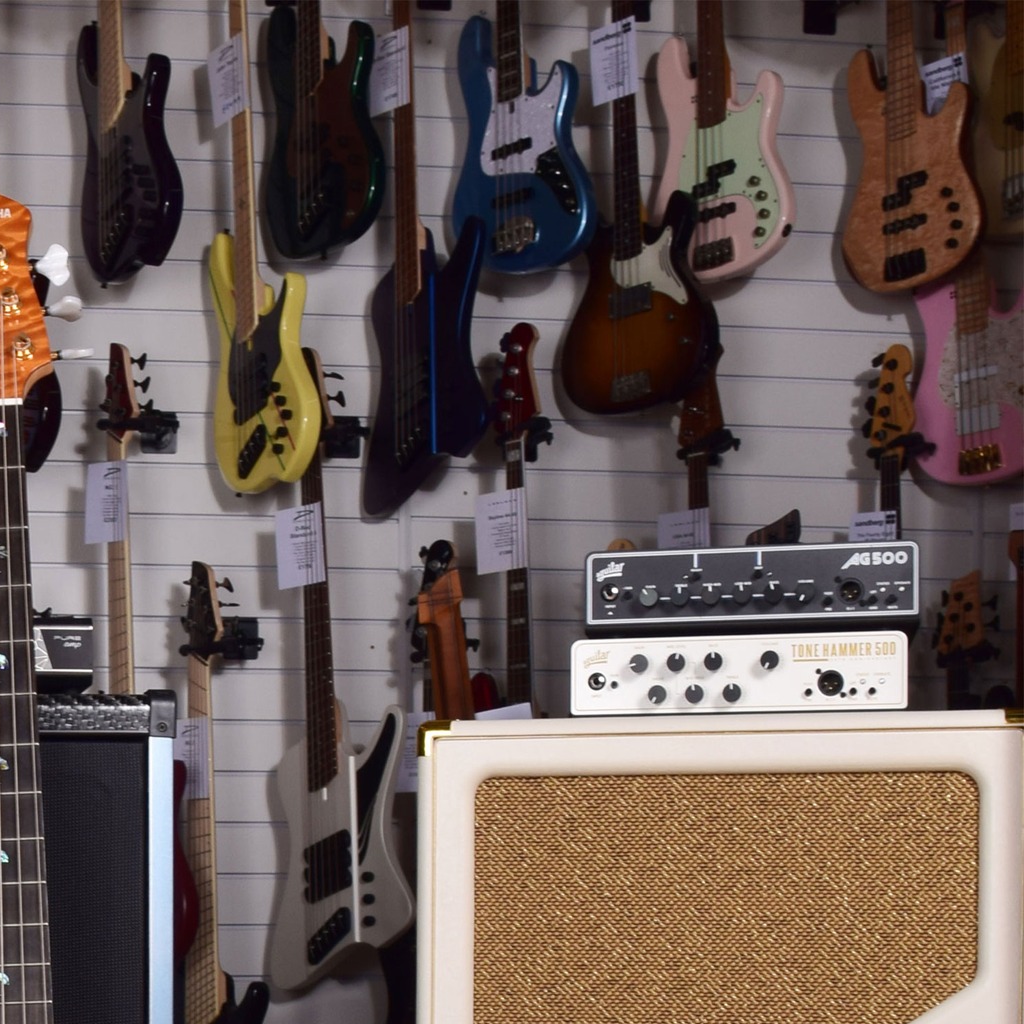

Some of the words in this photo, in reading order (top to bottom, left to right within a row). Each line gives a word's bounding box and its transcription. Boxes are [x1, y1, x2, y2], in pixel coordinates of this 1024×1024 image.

[840, 551, 908, 569] AG500
[791, 643, 819, 658] TONE
[822, 642, 872, 657] HAMMER
[875, 641, 896, 656] 500
